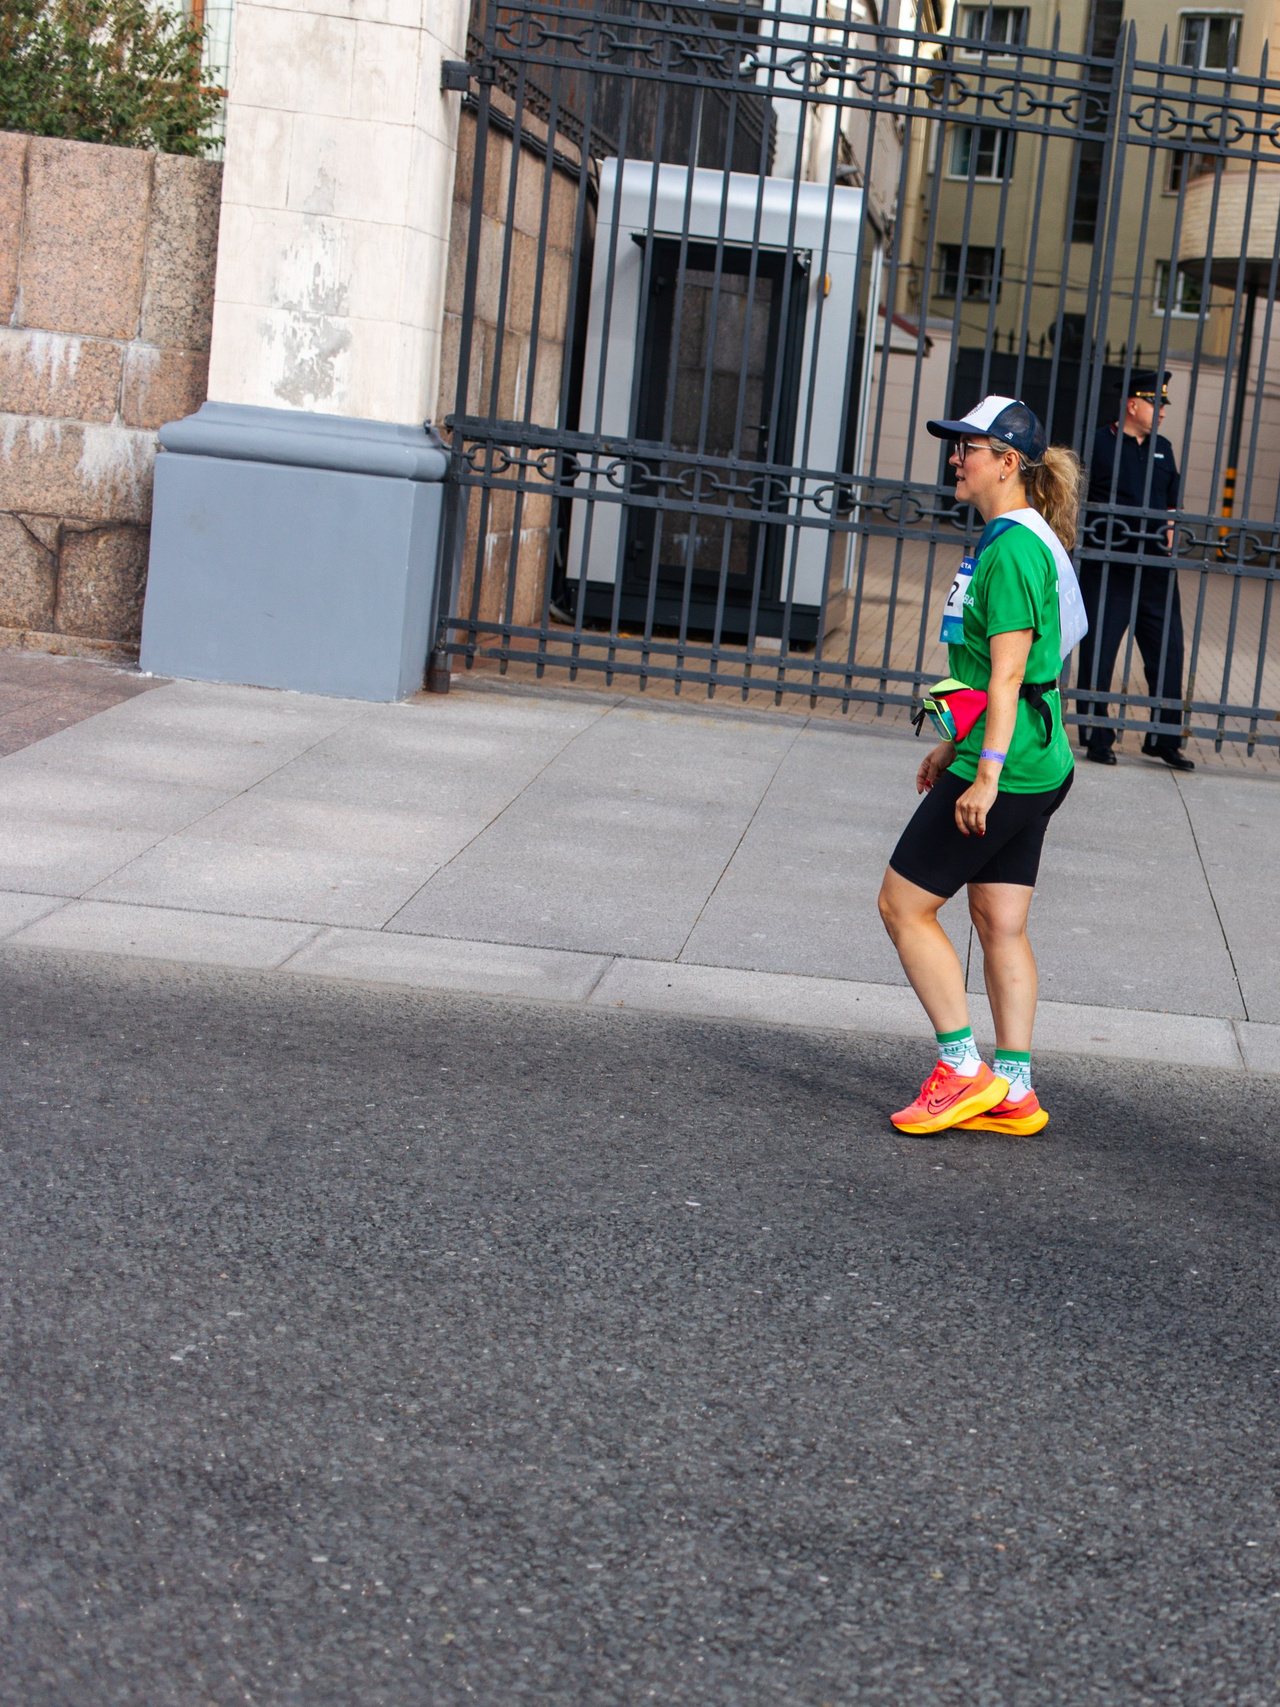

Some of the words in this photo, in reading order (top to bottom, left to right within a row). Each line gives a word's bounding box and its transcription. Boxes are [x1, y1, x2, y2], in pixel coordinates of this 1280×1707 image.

[947, 581, 960, 607] 2
[944, 1043, 973, 1053] NFL
[998, 1063, 1028, 1072] NFL
